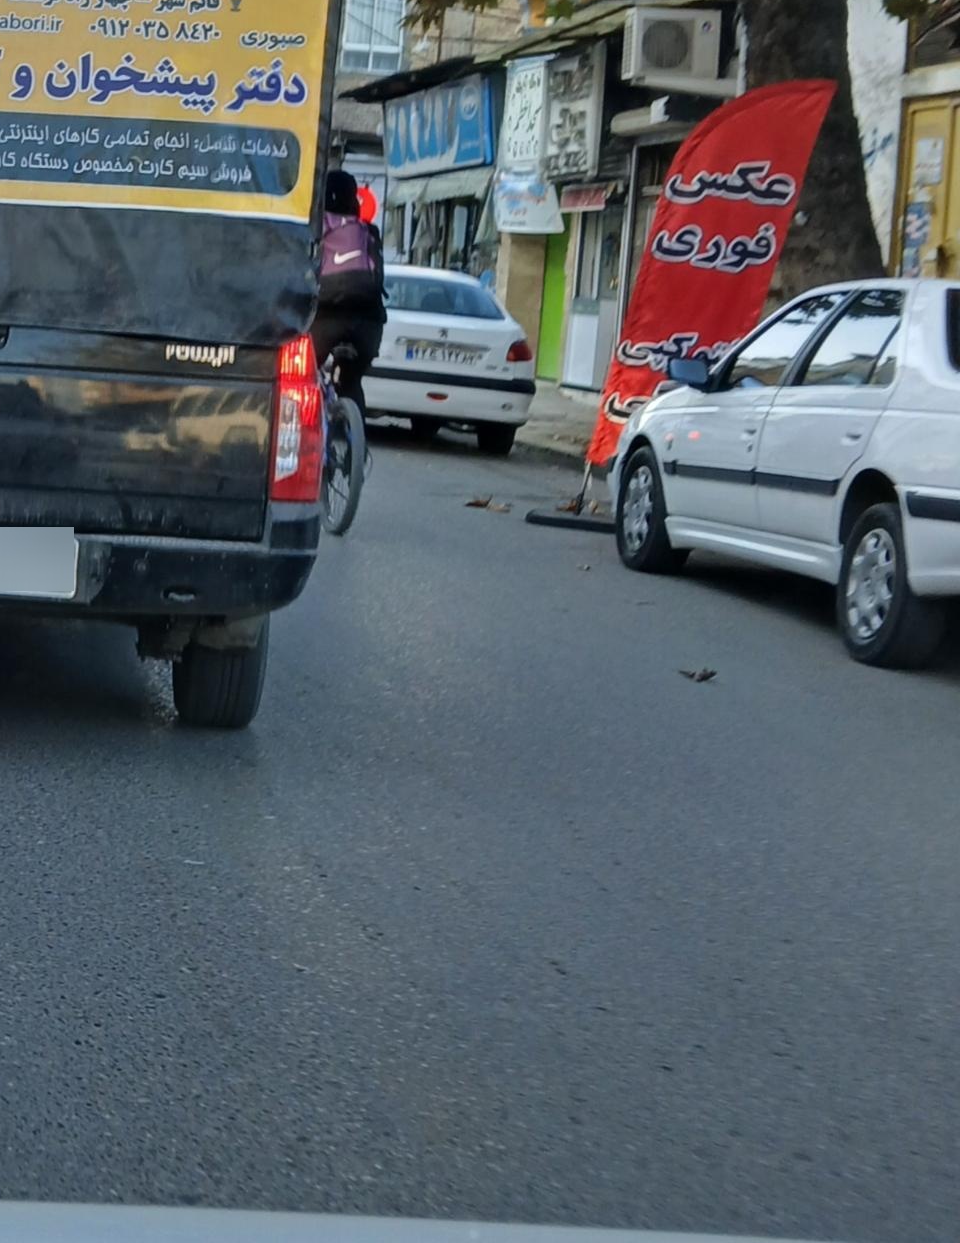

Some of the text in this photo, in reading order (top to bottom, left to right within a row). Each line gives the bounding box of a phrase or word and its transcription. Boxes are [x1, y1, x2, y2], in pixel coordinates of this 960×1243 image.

[241, 31, 305, 50] صبوری
[11, 63, 33, 98] و
[45, 52, 216, 114] پیشخوان
[225, 58, 307, 111] دفتر
[53, 126, 100, 147] کارهای
[104, 129, 149, 148] تمامی
[153, 131, 189, 150] انجام
[241, 138, 289, 158] خدمات
[20, 151, 69, 170] دستگاه
[73, 156, 134, 175] مخصوص
[211, 162, 253, 184] فروش
[664, 160, 796, 205] عکس
[651, 222, 777, 274] فوری
